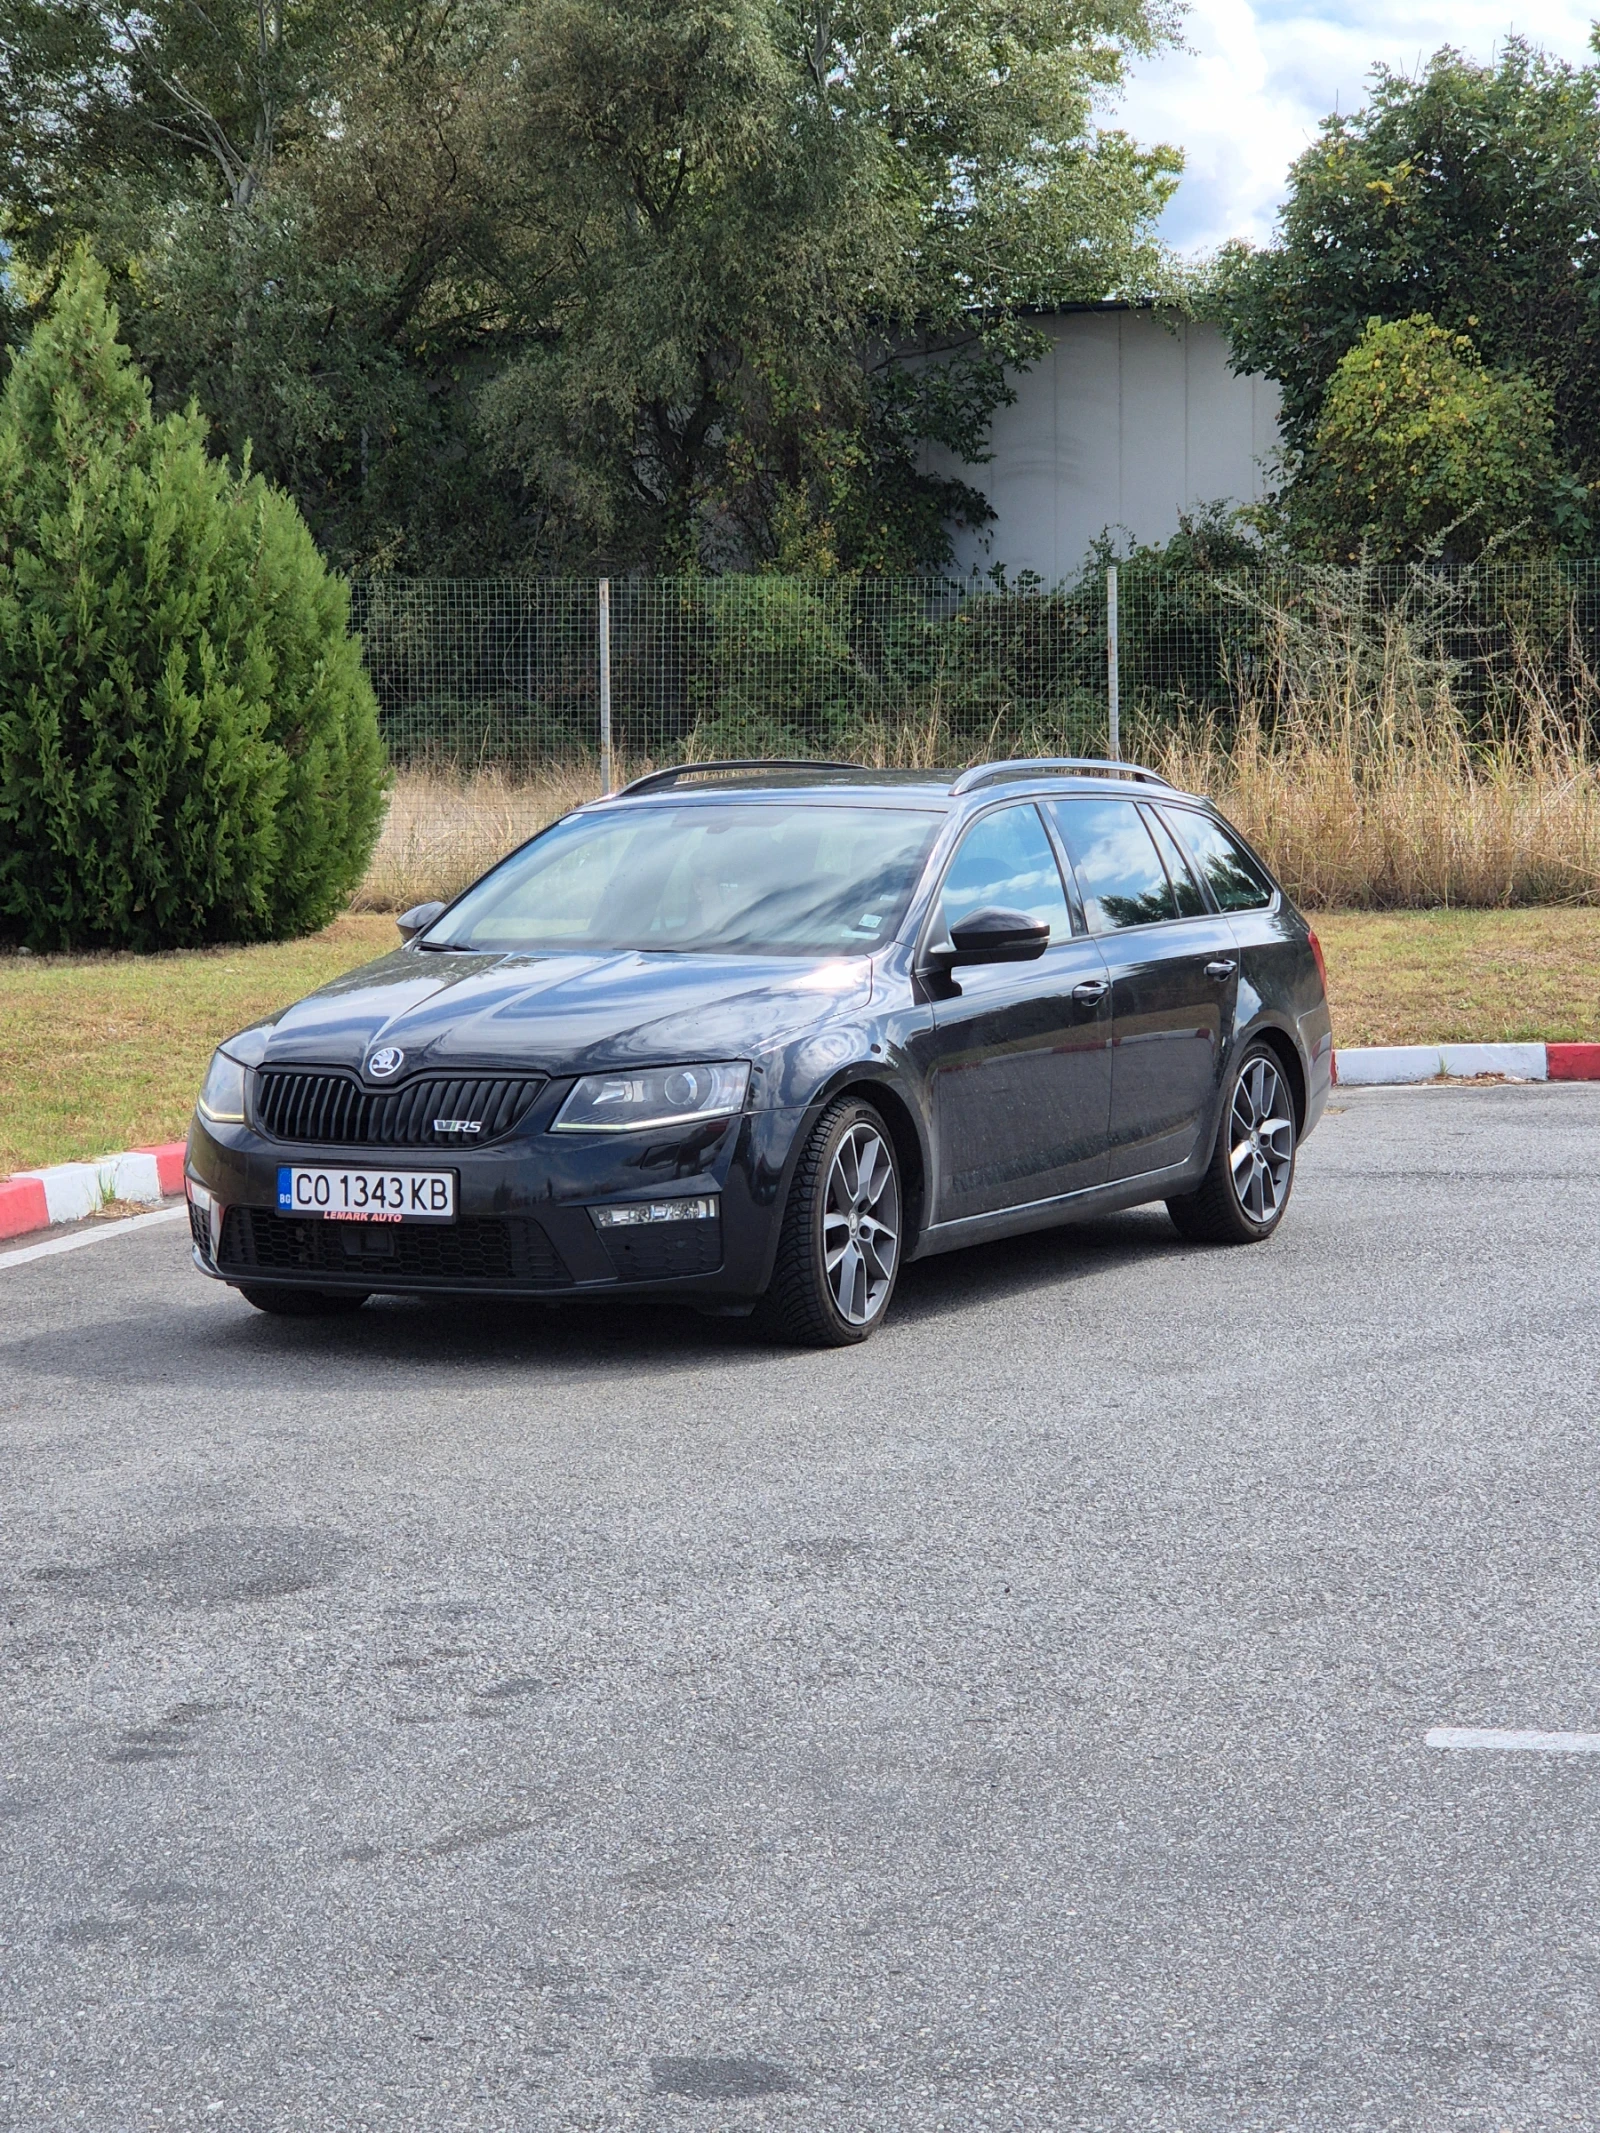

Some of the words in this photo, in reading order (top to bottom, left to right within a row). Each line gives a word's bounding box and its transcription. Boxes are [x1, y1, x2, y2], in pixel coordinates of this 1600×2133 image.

[296, 1173, 330, 1206] CO
[340, 1175, 404, 1209] 1343
[411, 1178, 448, 1211] KB
[279, 1193, 291, 1204] BG
[323, 1211, 369, 1222] LEMARK
[371, 1212, 403, 1223] AUTO
